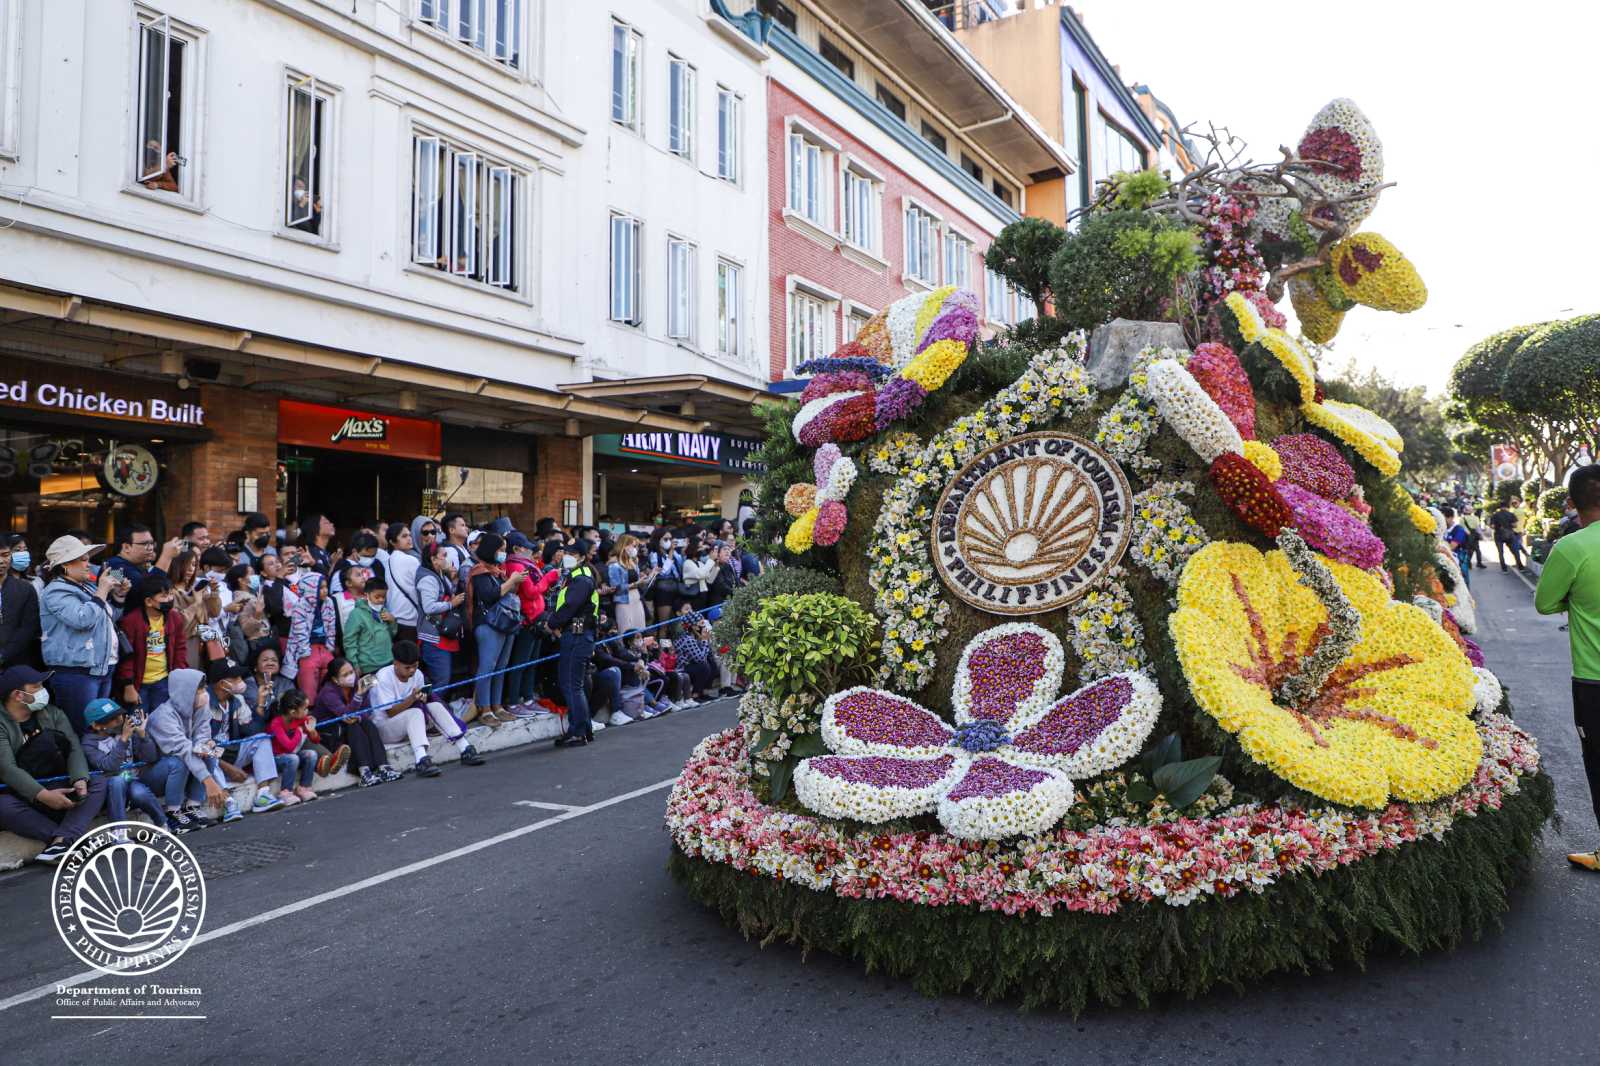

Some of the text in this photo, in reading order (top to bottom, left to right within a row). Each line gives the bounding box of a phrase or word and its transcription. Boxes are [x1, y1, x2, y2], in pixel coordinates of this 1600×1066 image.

[37, 384, 143, 417] Chicken
[151, 399, 204, 425] Built
[331, 417, 384, 440] Max's
[621, 433, 720, 460] ARMY NAVY
[939, 439, 1121, 543] DEPARTMENT OF TOURISM
[946, 547, 1106, 604] PHILIPPINES
